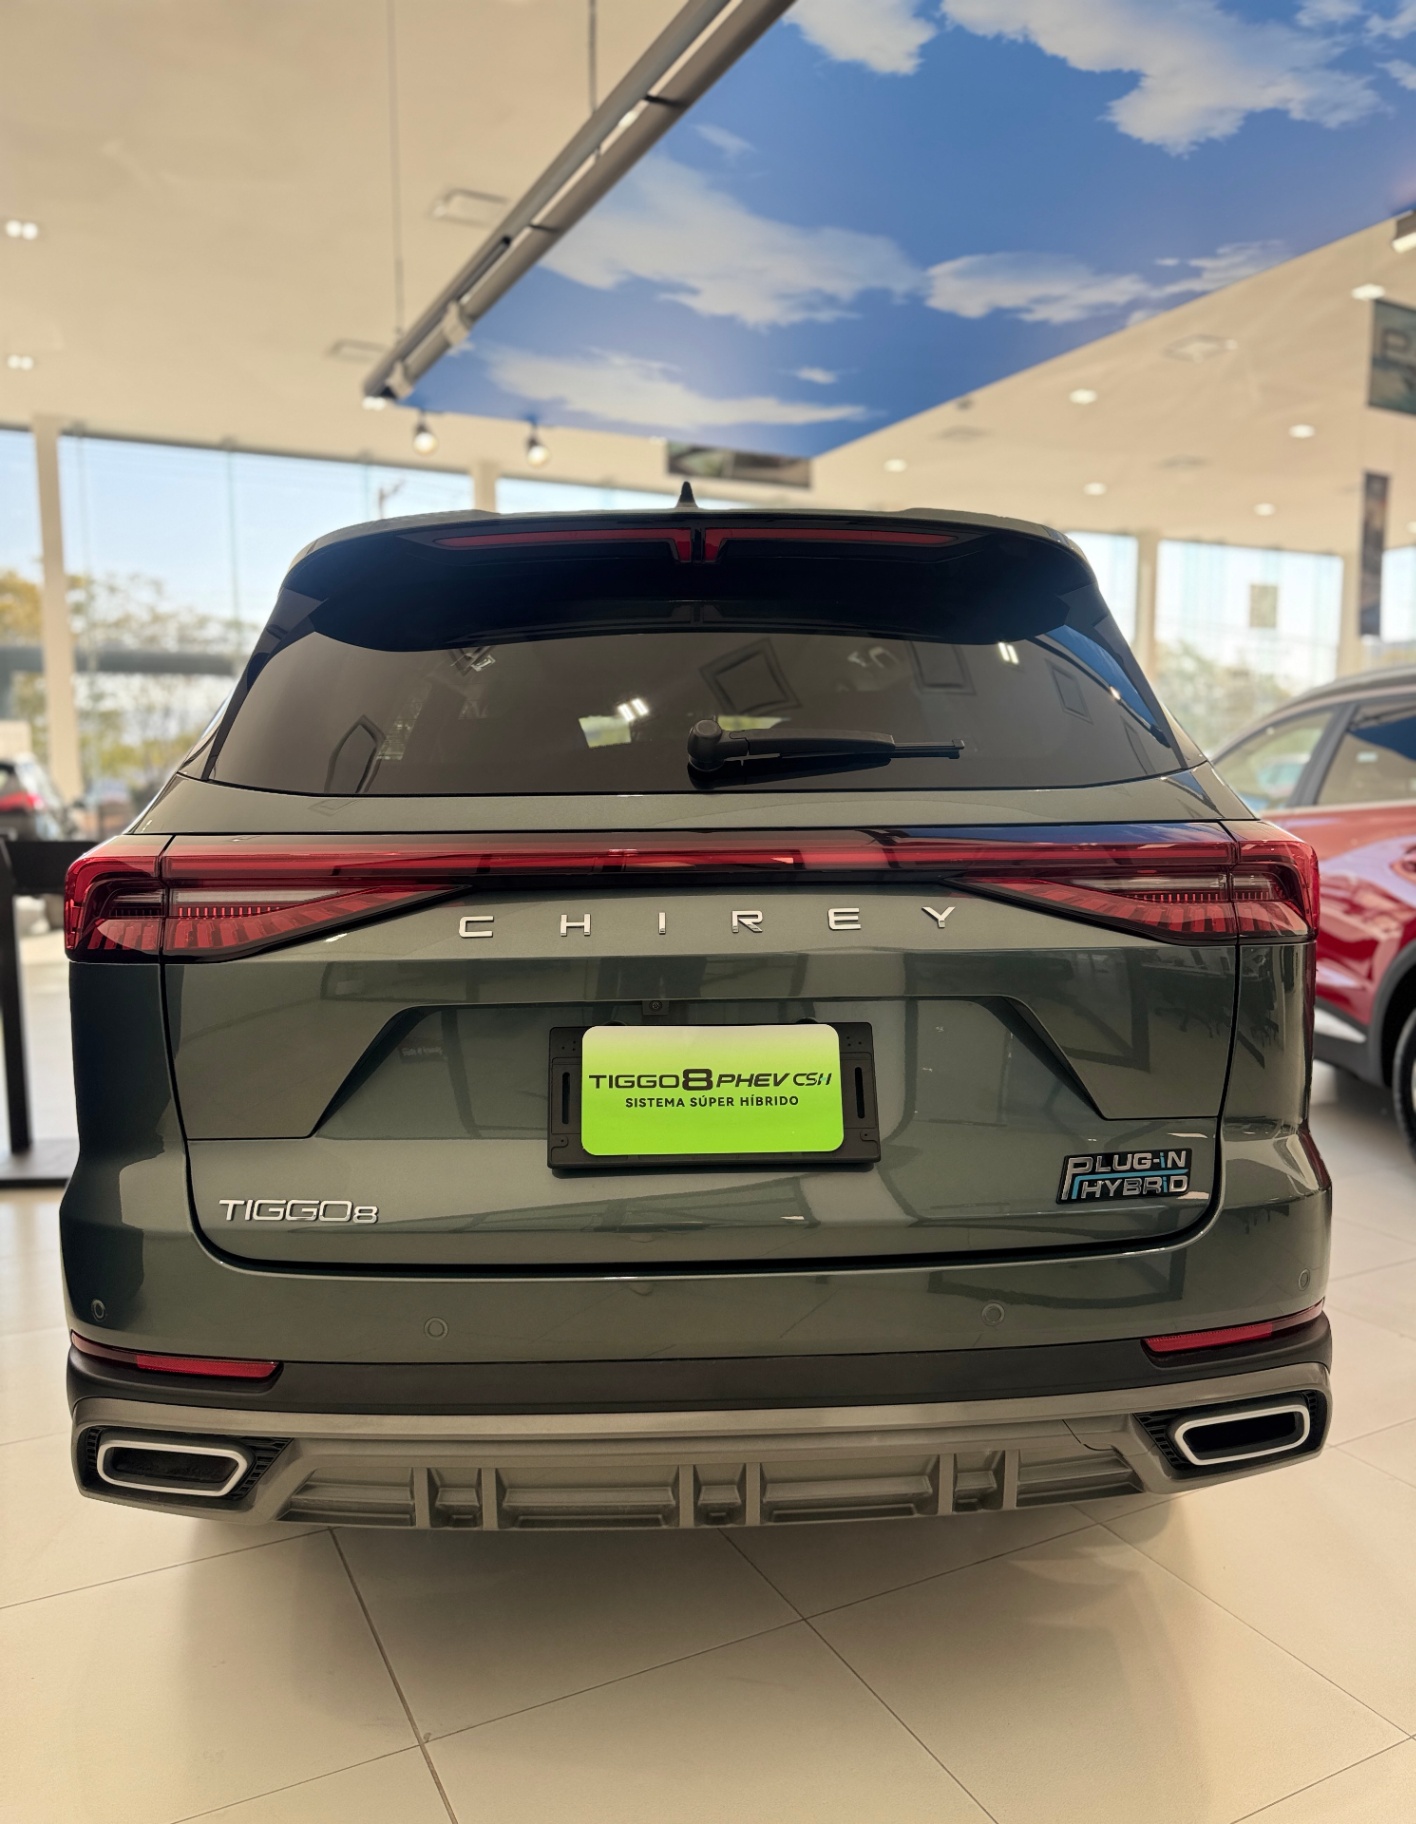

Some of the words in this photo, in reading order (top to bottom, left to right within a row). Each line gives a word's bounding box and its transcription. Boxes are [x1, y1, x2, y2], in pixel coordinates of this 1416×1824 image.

[458, 905, 956, 938] CHIREY
[625, 1097, 686, 1109] SISTEMA
[689, 1094, 736, 1108] SÚPER
[740, 1093, 800, 1108] HÍBRIDO
